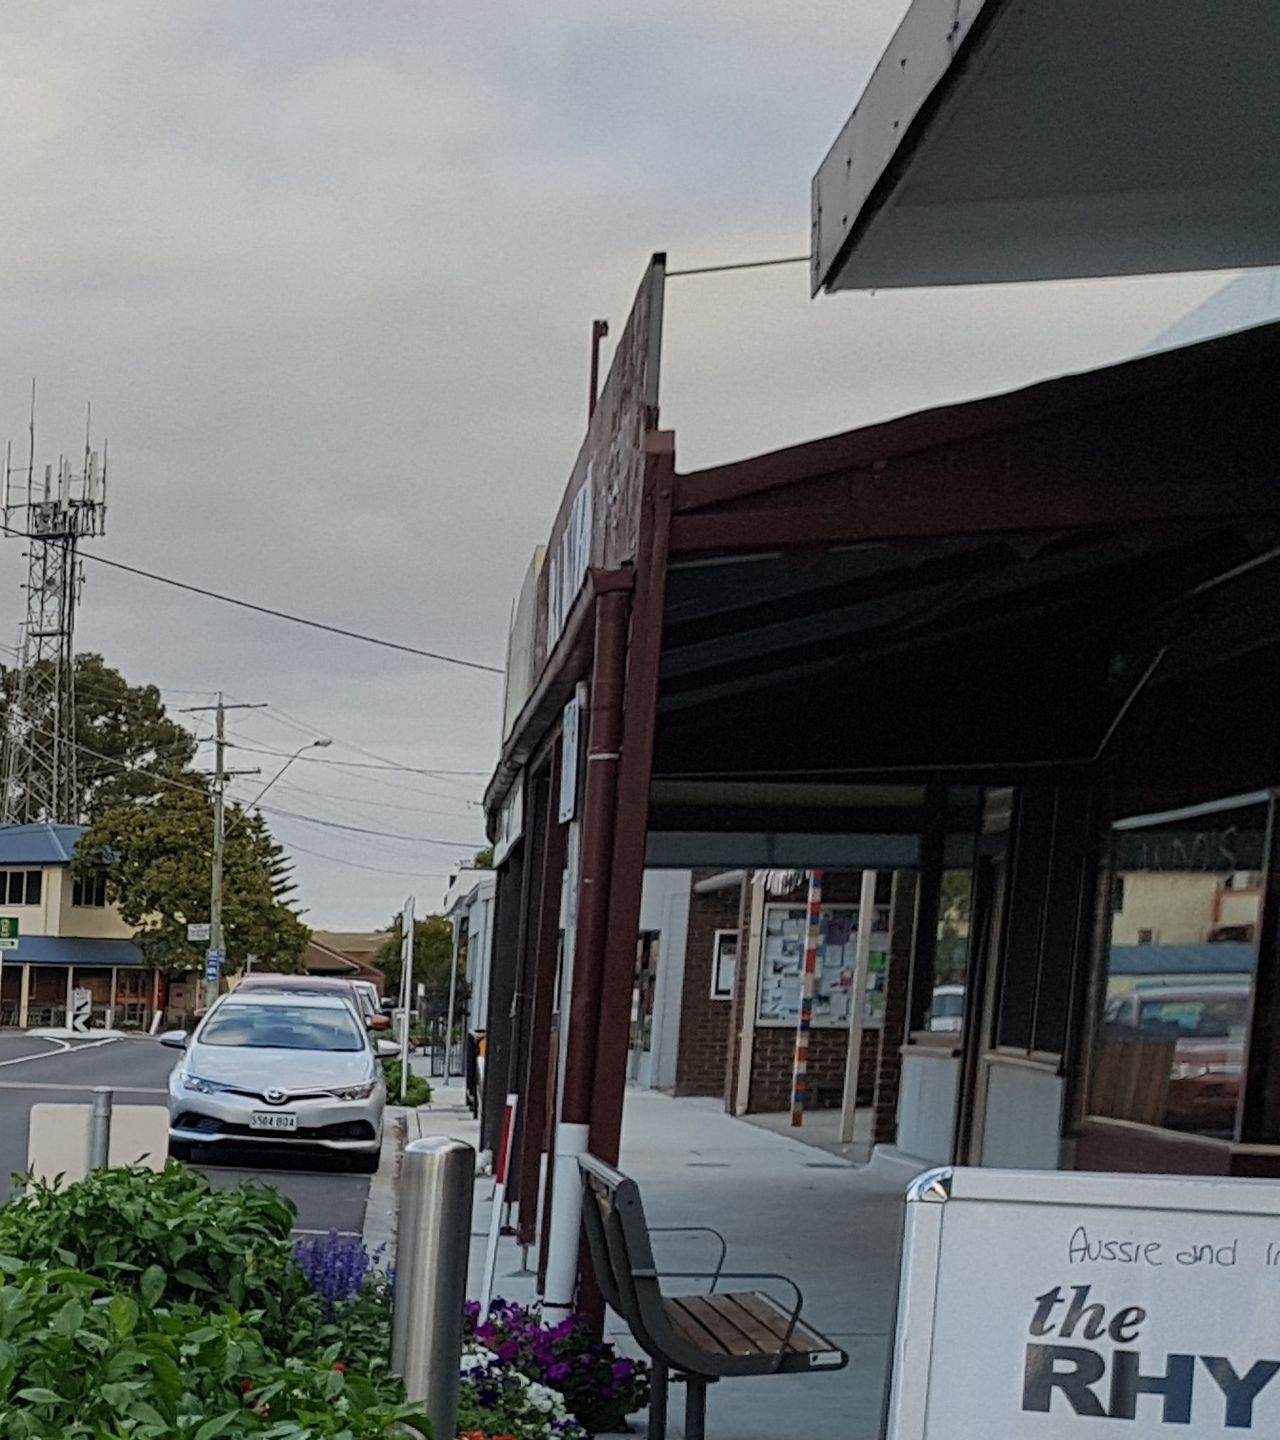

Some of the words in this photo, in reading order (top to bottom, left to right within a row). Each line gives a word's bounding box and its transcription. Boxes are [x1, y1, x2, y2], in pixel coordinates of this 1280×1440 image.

[1068, 1225, 1162, 1266] Aussie
[1175, 1238, 1238, 1266] and
[1028, 1284, 1146, 1344] the
[1022, 1343, 1280, 1428] RHY
